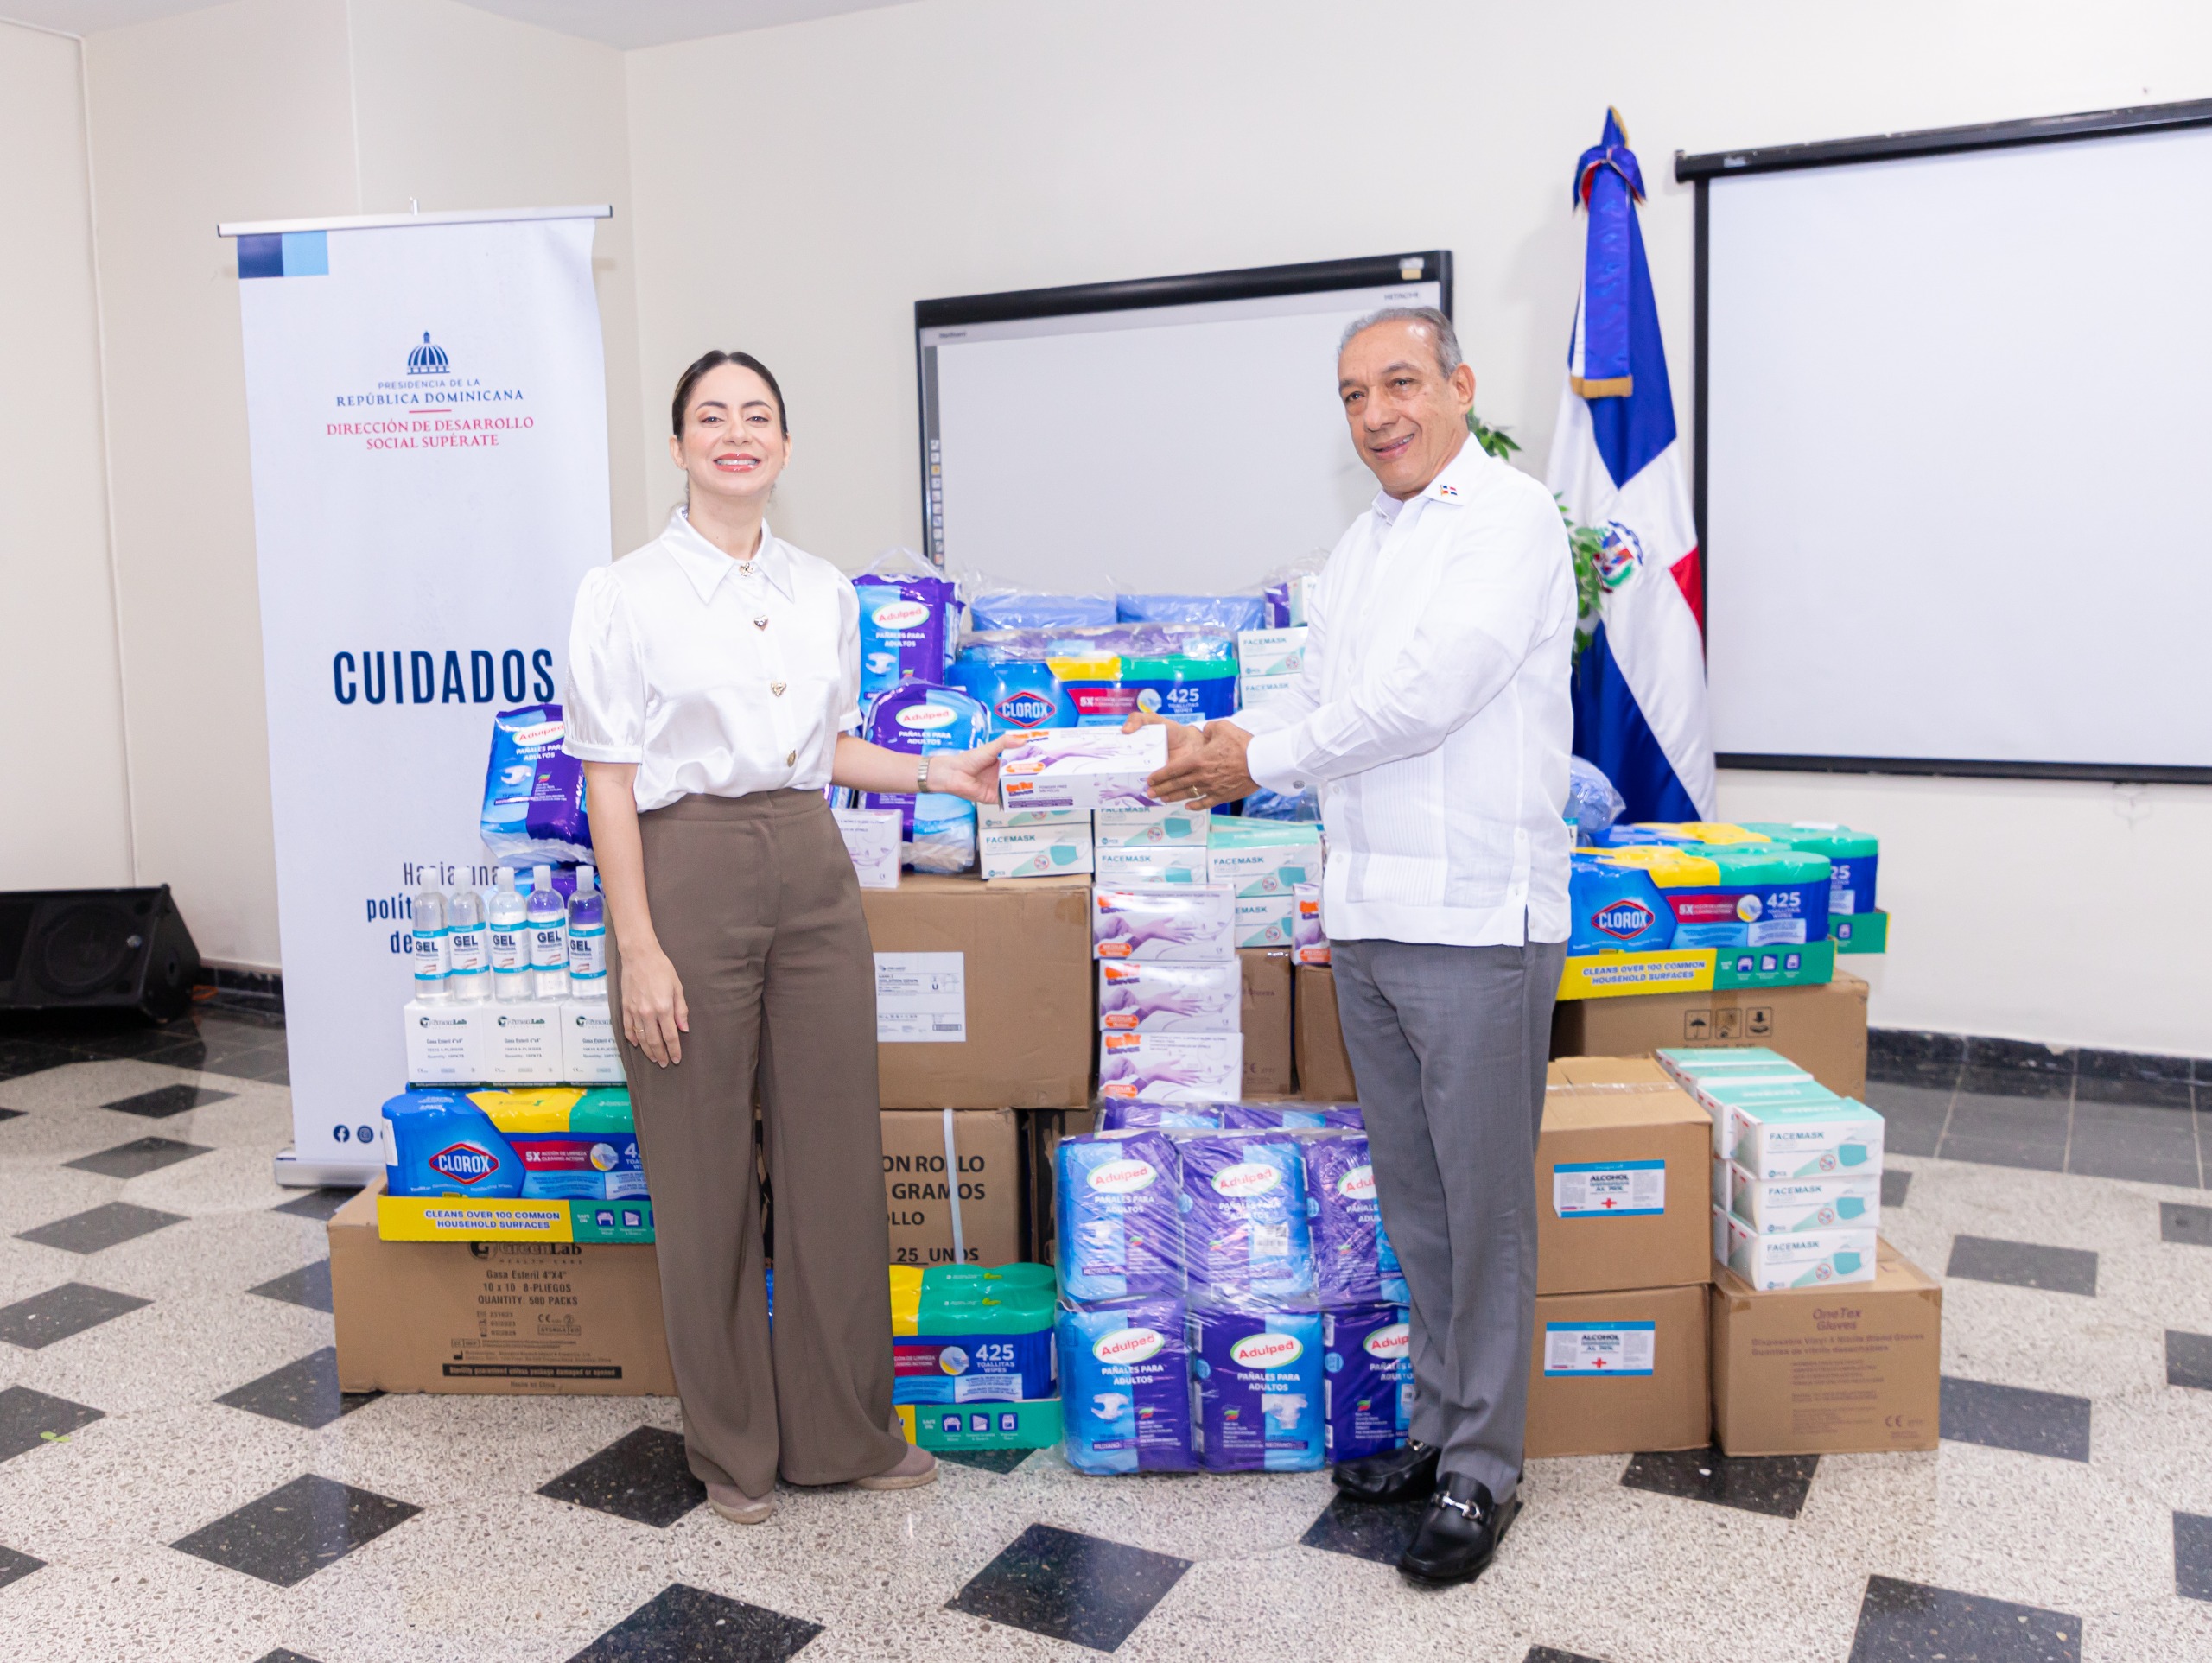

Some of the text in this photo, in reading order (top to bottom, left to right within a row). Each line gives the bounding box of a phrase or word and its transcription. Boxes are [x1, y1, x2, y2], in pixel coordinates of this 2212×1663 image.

[378, 381, 446, 390] PRESIDENCIA
[337, 390, 524, 407] REPÚBLICA DOMINICANA
[327, 417, 534, 435] DIRECCIÓN DE DESARROLLO
[366, 432, 499, 450] SOCIAL SUPÉRATE
[879, 607, 922, 622] Adulped
[333, 648, 555, 705] CUIDADOS
[1246, 682, 1289, 691] FACEMASK
[1166, 688, 1199, 703] 425
[903, 710, 949, 722] Adulped
[1001, 702, 1049, 718] CLOROX
[516, 745, 546, 755] PAÑALES
[986, 835, 1035, 843] FACEMASK
[404, 862, 455, 885] Haia
[1830, 865, 1851, 879] 25
[1766, 892, 1801, 907] 425
[367, 892, 412, 922] polít
[1599, 911, 1648, 929] CLOROX
[390, 931, 413, 954] de
[454, 935, 478, 947] GEL
[493, 935, 516, 945] GEL
[537, 931, 561, 943] GEL
[416, 941, 438, 952] GEL
[570, 940, 591, 951] GEL
[1583, 967, 1618, 975] CLEANS
[1592, 972, 1694, 984] HOUSEHOLD SURFACES
[1770, 1132, 1824, 1140] FACEMASK
[525, 1151, 541, 1162] 5X
[882, 1155, 985, 1172] ON ROLO
[438, 1155, 490, 1173] CLOROX
[1096, 1167, 1147, 1185] Adulped
[1220, 1169, 1272, 1189] Adulped
[1345, 1175, 1376, 1192] Adul
[892, 1183, 985, 1200] GRAMOS
[1768, 1186, 1821, 1196] FACEMASK
[887, 1211, 925, 1225] LLO
[1767, 1241, 1819, 1252] FACEMASK
[897, 1247, 918, 1261] 25
[486, 1270, 508, 1279] Gasa
[512, 1270, 539, 1279] Esteril
[484, 1283, 493, 1292] 10
[506, 1283, 516, 1292] 10
[524, 1283, 571, 1292] 8-PLIEGOS
[478, 1295, 578, 1305] QUANTITY: 500 PACKS
[1816, 1321, 1857, 1330] Gloves
[1101, 1334, 1155, 1356] Adulped
[1372, 1335, 1409, 1349] Adulp
[976, 1344, 1014, 1362] 425
[1239, 1341, 1294, 1359] Adulped
[1102, 1366, 1140, 1375] PAÑALES
[1237, 1372, 1275, 1381] PAÑALES
[1114, 1375, 1153, 1385] ADULTOS
